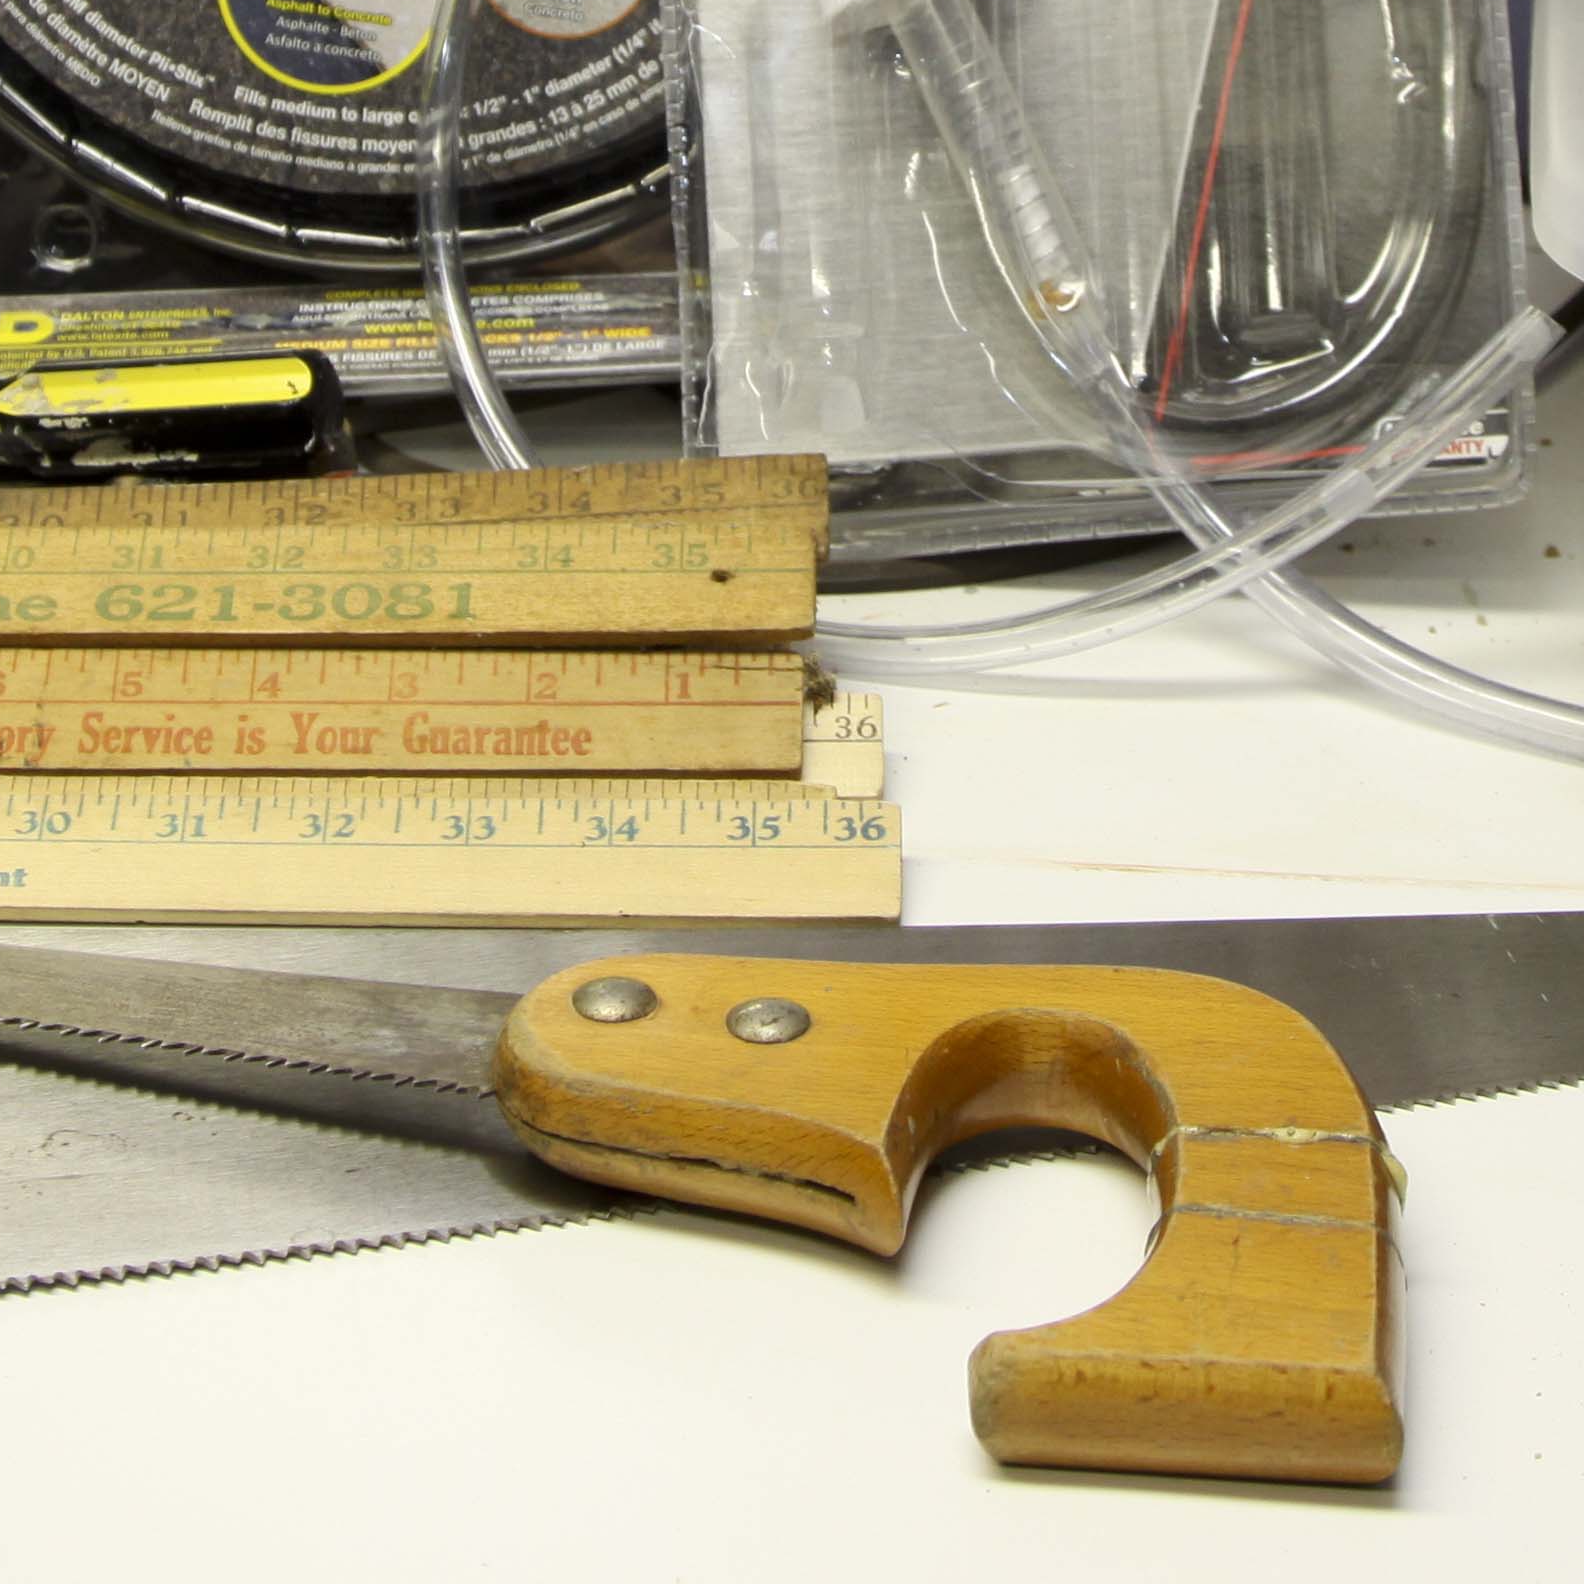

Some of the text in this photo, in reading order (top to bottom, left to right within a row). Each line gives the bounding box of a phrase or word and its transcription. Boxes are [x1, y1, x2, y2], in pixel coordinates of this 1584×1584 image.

[93, 580, 482, 624] 621-3081
[119, 671, 144, 698] 5
[255, 673, 283, 699] 4
[393, 673, 419, 699] 3
[533, 674, 558, 700] 2
[673, 676, 694, 701] 1
[77, 713, 214, 756] Service
[234, 714, 266, 756] is
[288, 710, 382, 756] Your
[401, 711, 594, 758] Guarantee
[833, 715, 879, 740] 36
[833, 816, 887, 843] 36
